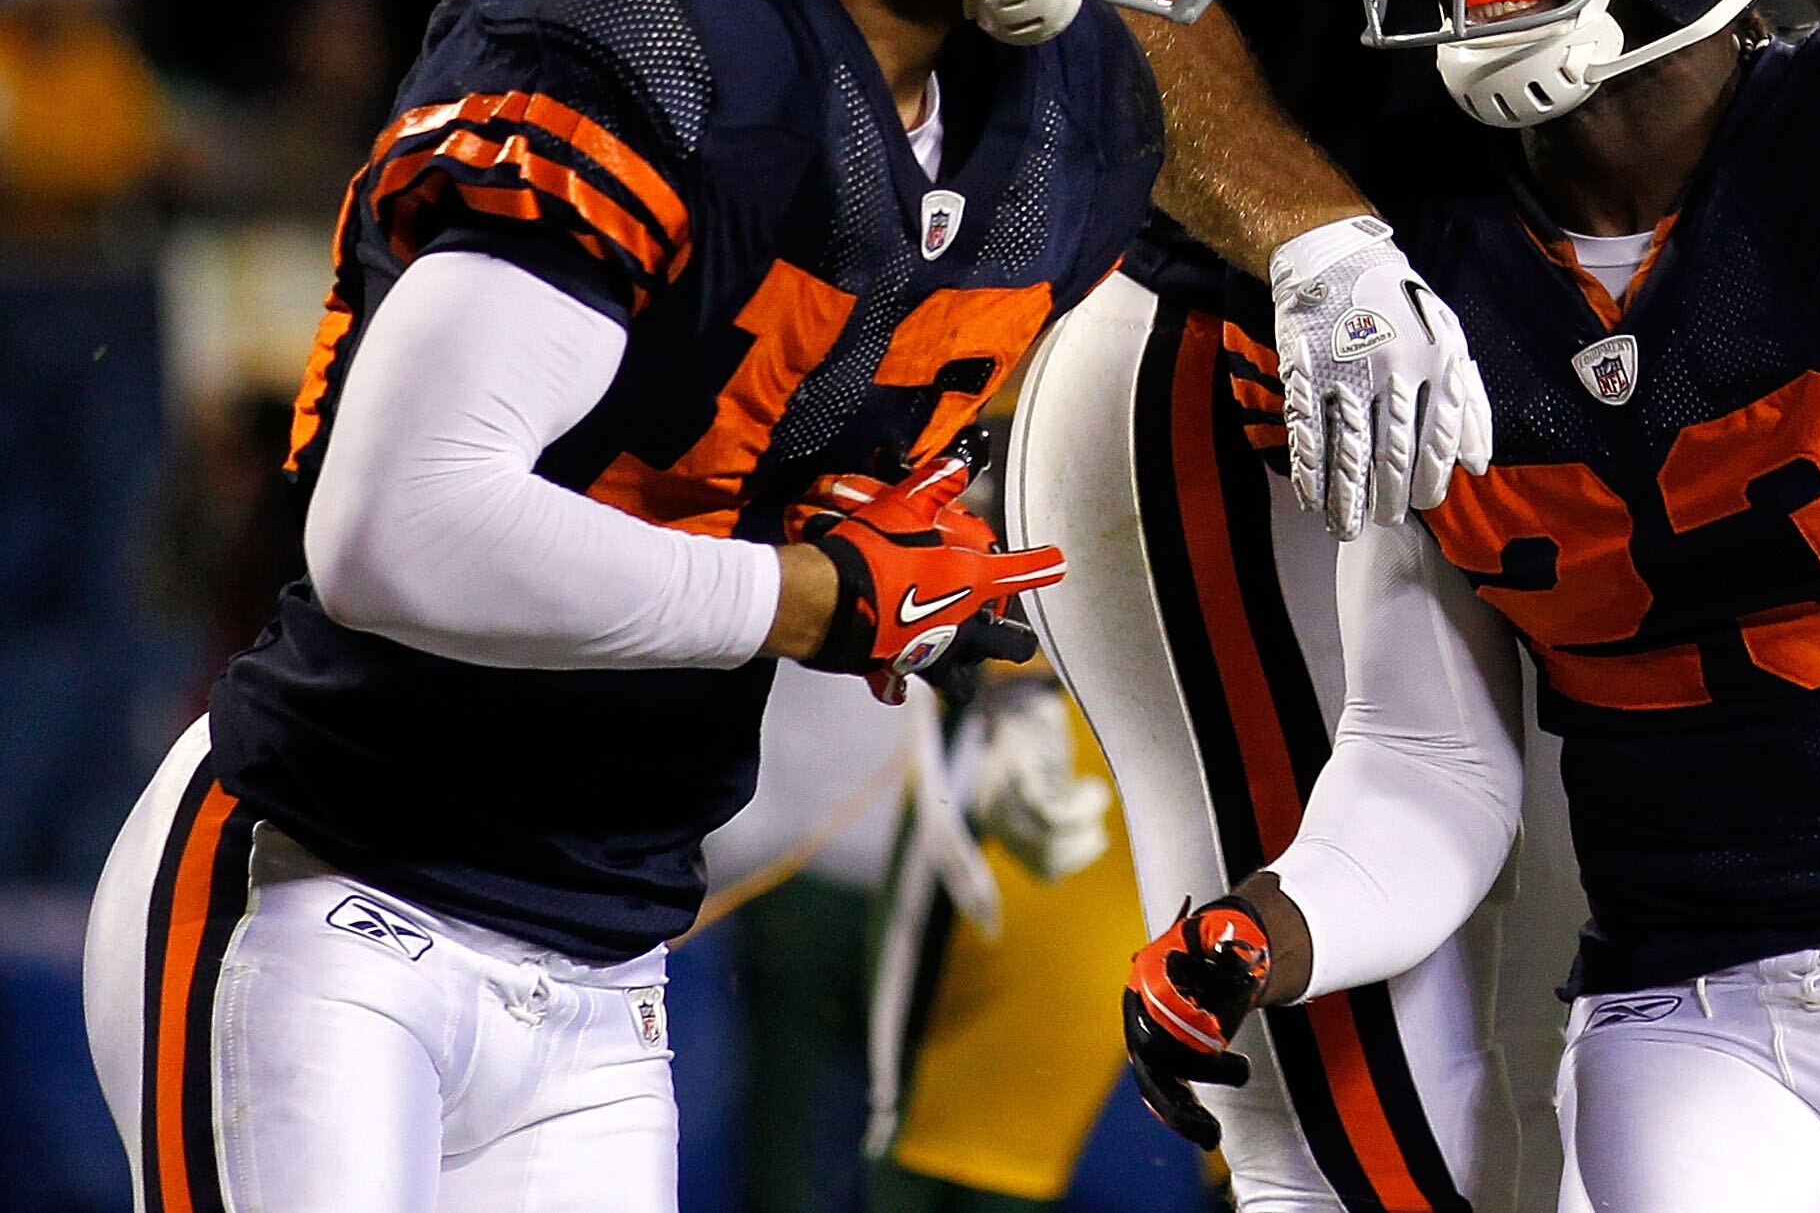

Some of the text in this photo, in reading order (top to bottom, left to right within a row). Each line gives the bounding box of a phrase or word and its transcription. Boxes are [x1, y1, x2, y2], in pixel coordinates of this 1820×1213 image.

[1346, 317, 1371, 334] NFL
[1341, 332, 1392, 354] EQUIPMENT
[1600, 371, 1627, 394] NFL
